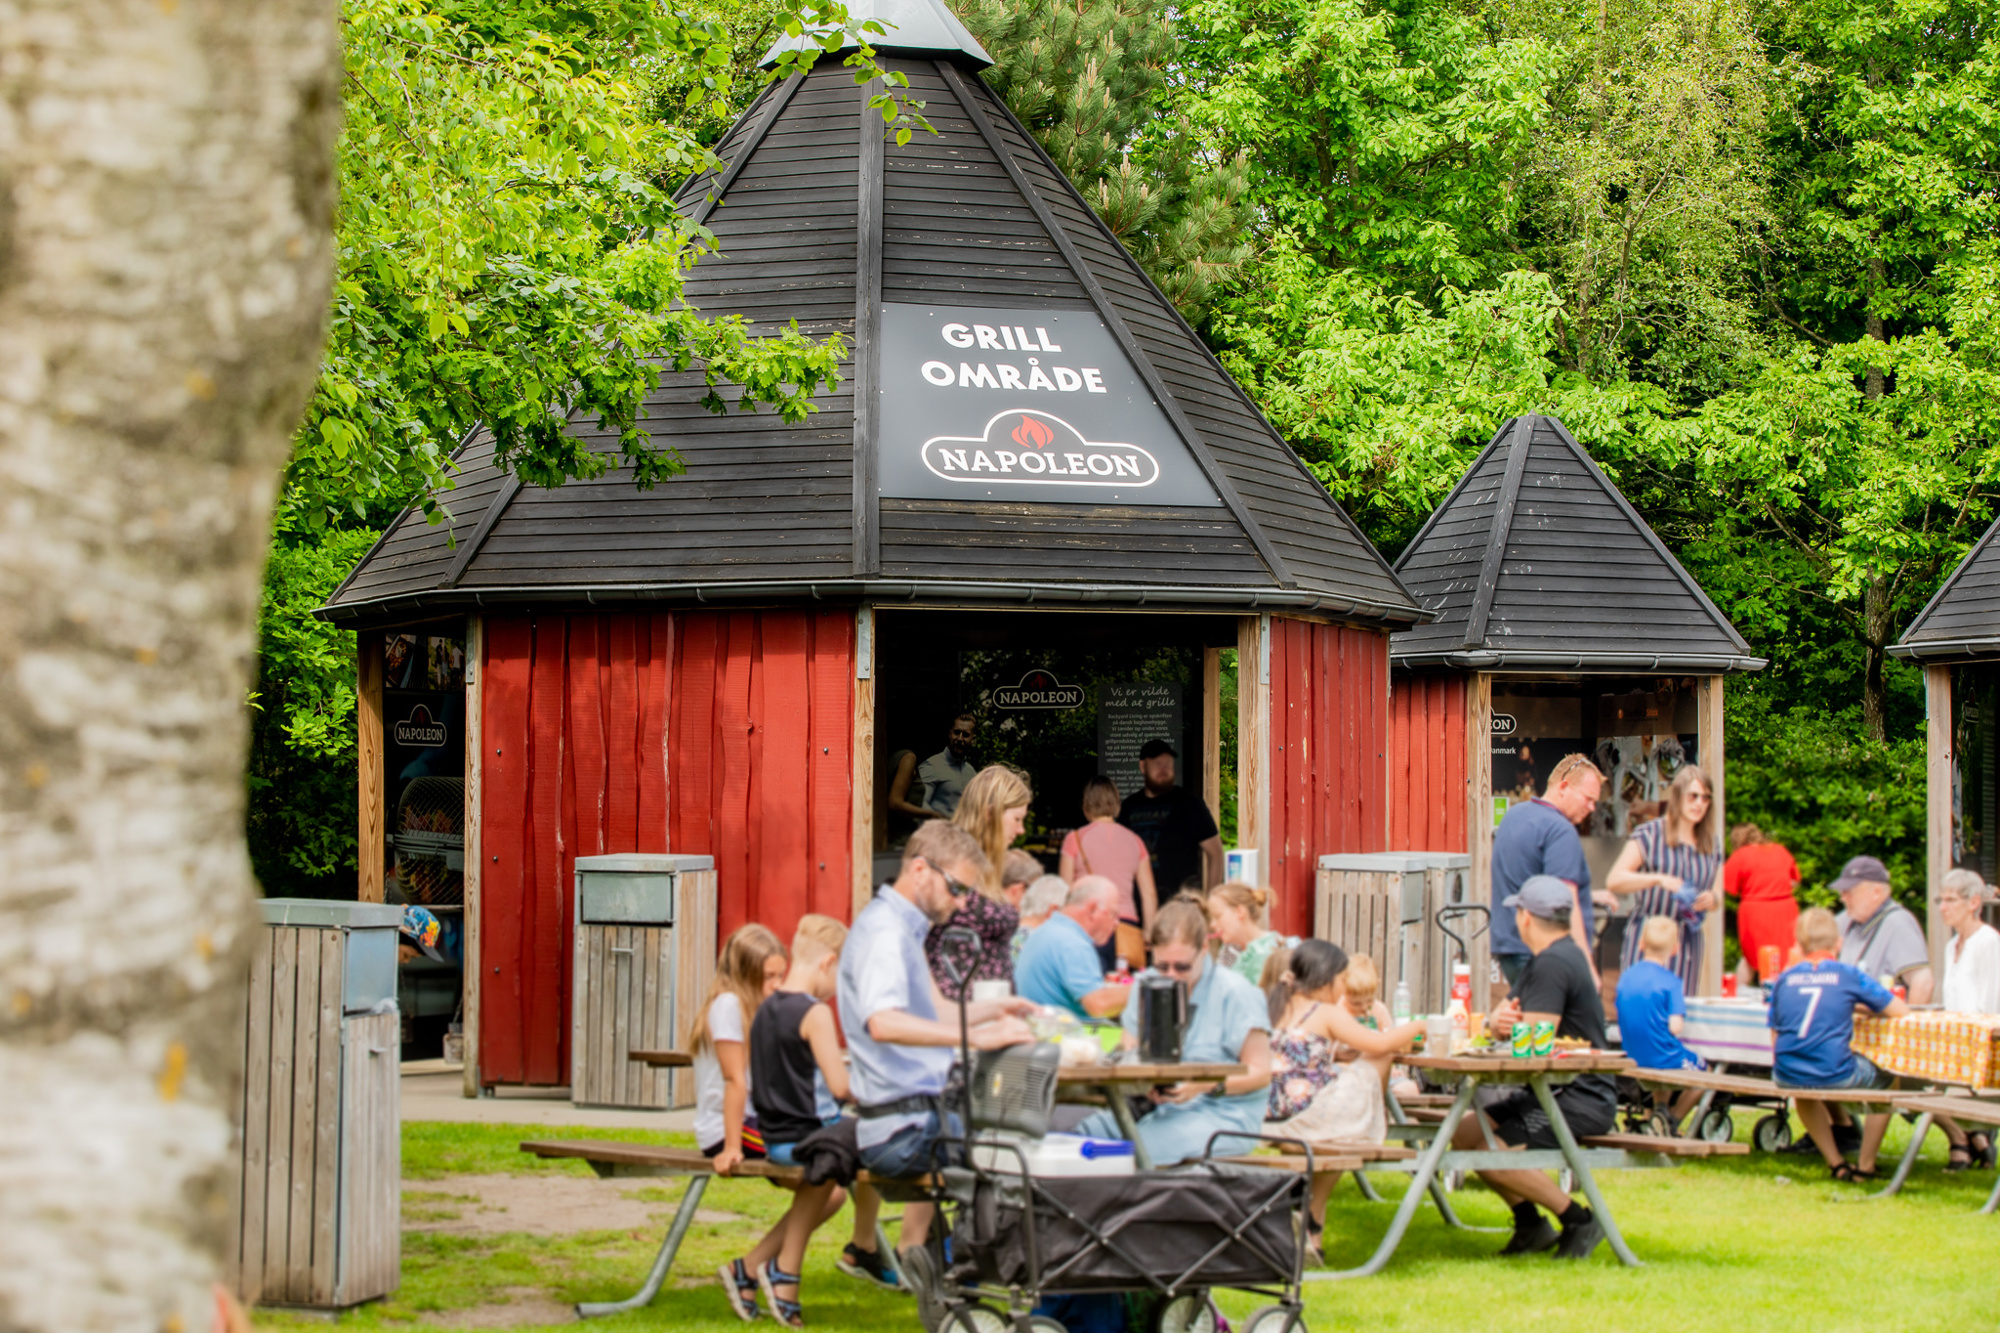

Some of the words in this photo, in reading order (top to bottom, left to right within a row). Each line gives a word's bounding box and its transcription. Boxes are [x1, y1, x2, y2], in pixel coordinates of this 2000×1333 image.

[941, 323, 1062, 352] GRILL
[921, 357, 1107, 394] OMRÅDE
[938, 448, 1141, 477] NAPOLEON
[1000, 691, 1077, 704] NAPOLEON
[1110, 687, 1123, 696] Vi
[1141, 686, 1170, 696] vilde
[1105, 697, 1128, 707] med
[1131, 699, 1144, 707] at
[1146, 697, 1176, 709] grille
[398, 727, 443, 741] NAPOLEON
[1491, 747, 1516, 755] anmark
[1798, 986, 1823, 1038] 7
